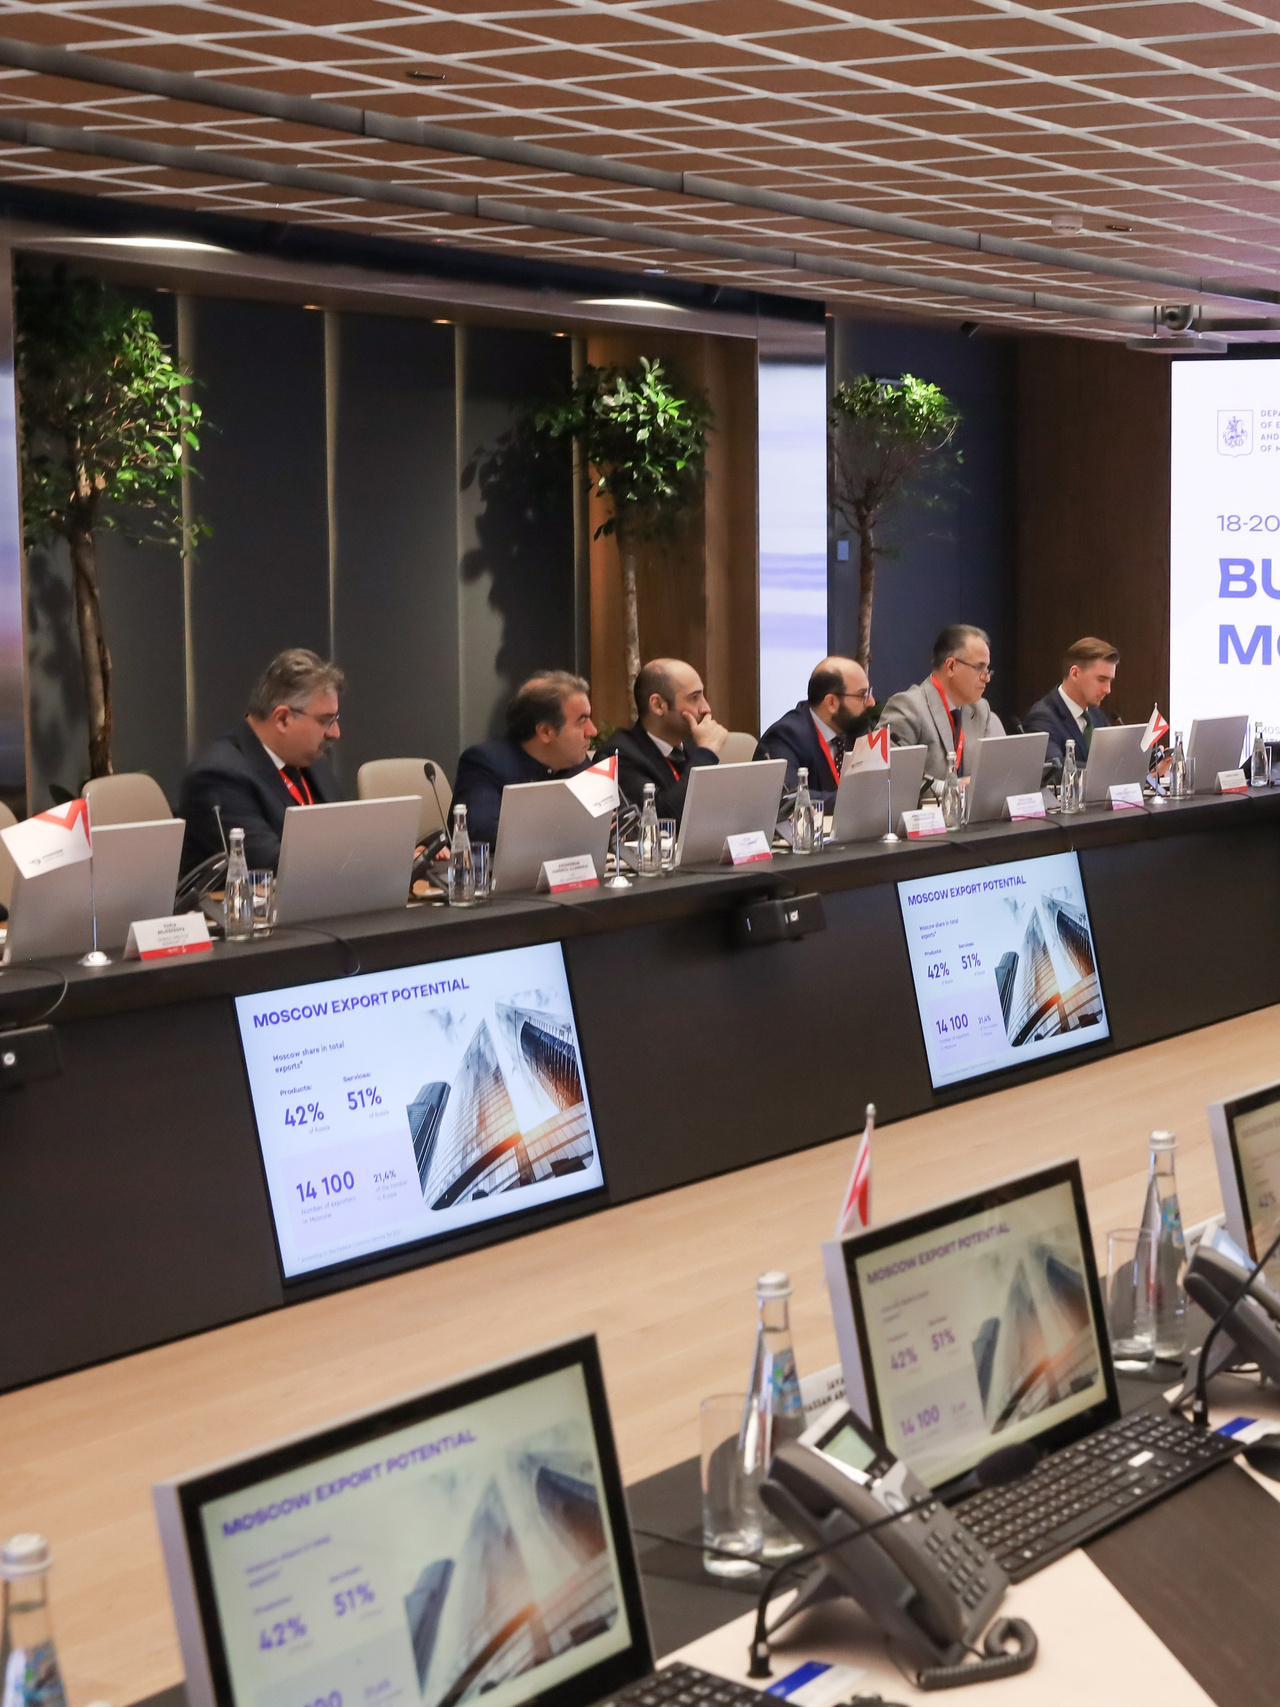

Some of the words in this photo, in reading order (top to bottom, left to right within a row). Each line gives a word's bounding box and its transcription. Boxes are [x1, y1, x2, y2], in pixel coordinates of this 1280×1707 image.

[1260, 421, 1273, 429] OF
[1260, 432, 1278, 440] AND
[1260, 444, 1272, 452] OF
[1216, 514, 1280, 532] 18-20
[908, 888, 949, 906] MOSCOW
[950, 882, 982, 898] EXPORT
[983, 874, 1027, 891] POTENTIAL
[927, 961, 950, 980] 42%
[961, 952, 982, 970] 51%
[253, 1000, 328, 1028] MOSCOW
[331, 991, 389, 1014] EXPORT
[391, 977, 470, 1002] POTENTIAL
[936, 1019, 948, 1035] 14
[949, 1012, 969, 1031] 100
[273, 1050, 301, 1062] Moscow
[302, 1046, 321, 1057] share
[321, 1044, 329, 1054] in
[329, 1040, 345, 1052] total
[279, 1084, 313, 1097] Products:
[346, 1086, 382, 1111] 51%
[284, 1101, 325, 1127] 42%
[295, 1180, 318, 1203] 14
[321, 1170, 355, 1196] 100
[373, 1168, 397, 1184] 21,4%
[866, 1255, 917, 1285] MOSCOW
[918, 1241, 957, 1266] EXPORT
[958, 1222, 1011, 1250] POTENTIAL
[931, 1328, 956, 1352] 51%
[890, 1347, 918, 1372] 42%
[916, 1404, 940, 1430] 100
[222, 1490, 312, 1538] MOSCOW
[315, 1462, 383, 1503] EXPORT
[386, 1429, 477, 1475] POTENTIAL
[332, 1581, 376, 1618] 51%
[258, 1614, 308, 1651] 42%
